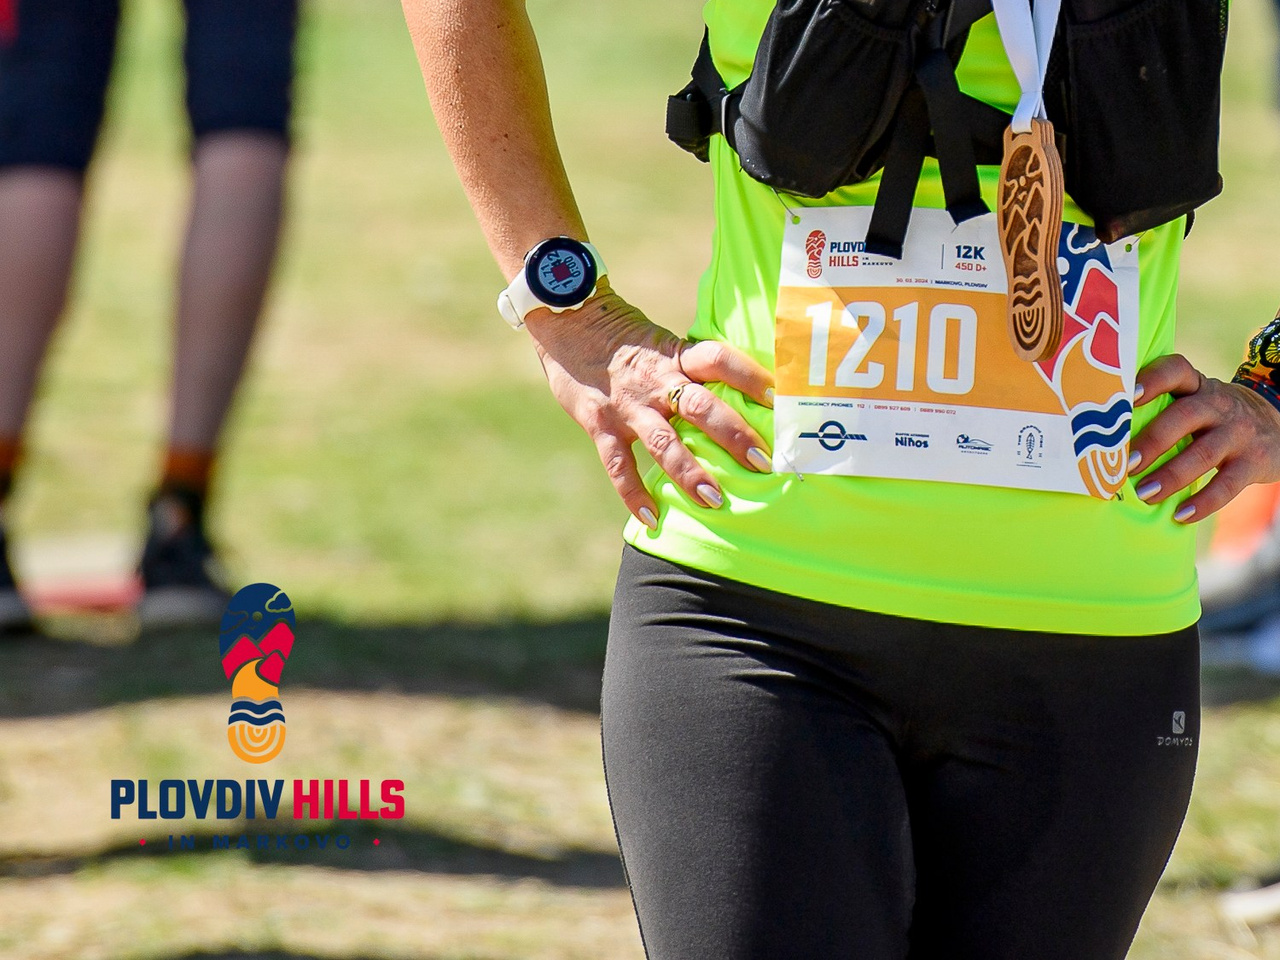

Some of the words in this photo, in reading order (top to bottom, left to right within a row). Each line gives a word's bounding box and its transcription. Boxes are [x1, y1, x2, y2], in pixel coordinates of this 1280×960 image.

[830, 241, 867, 253] PLOVD
[955, 245, 986, 261] 12K
[829, 255, 859, 267] HILLS
[955, 262, 973, 271] 450
[976, 263, 987, 273] D+
[805, 300, 978, 396] 1210
